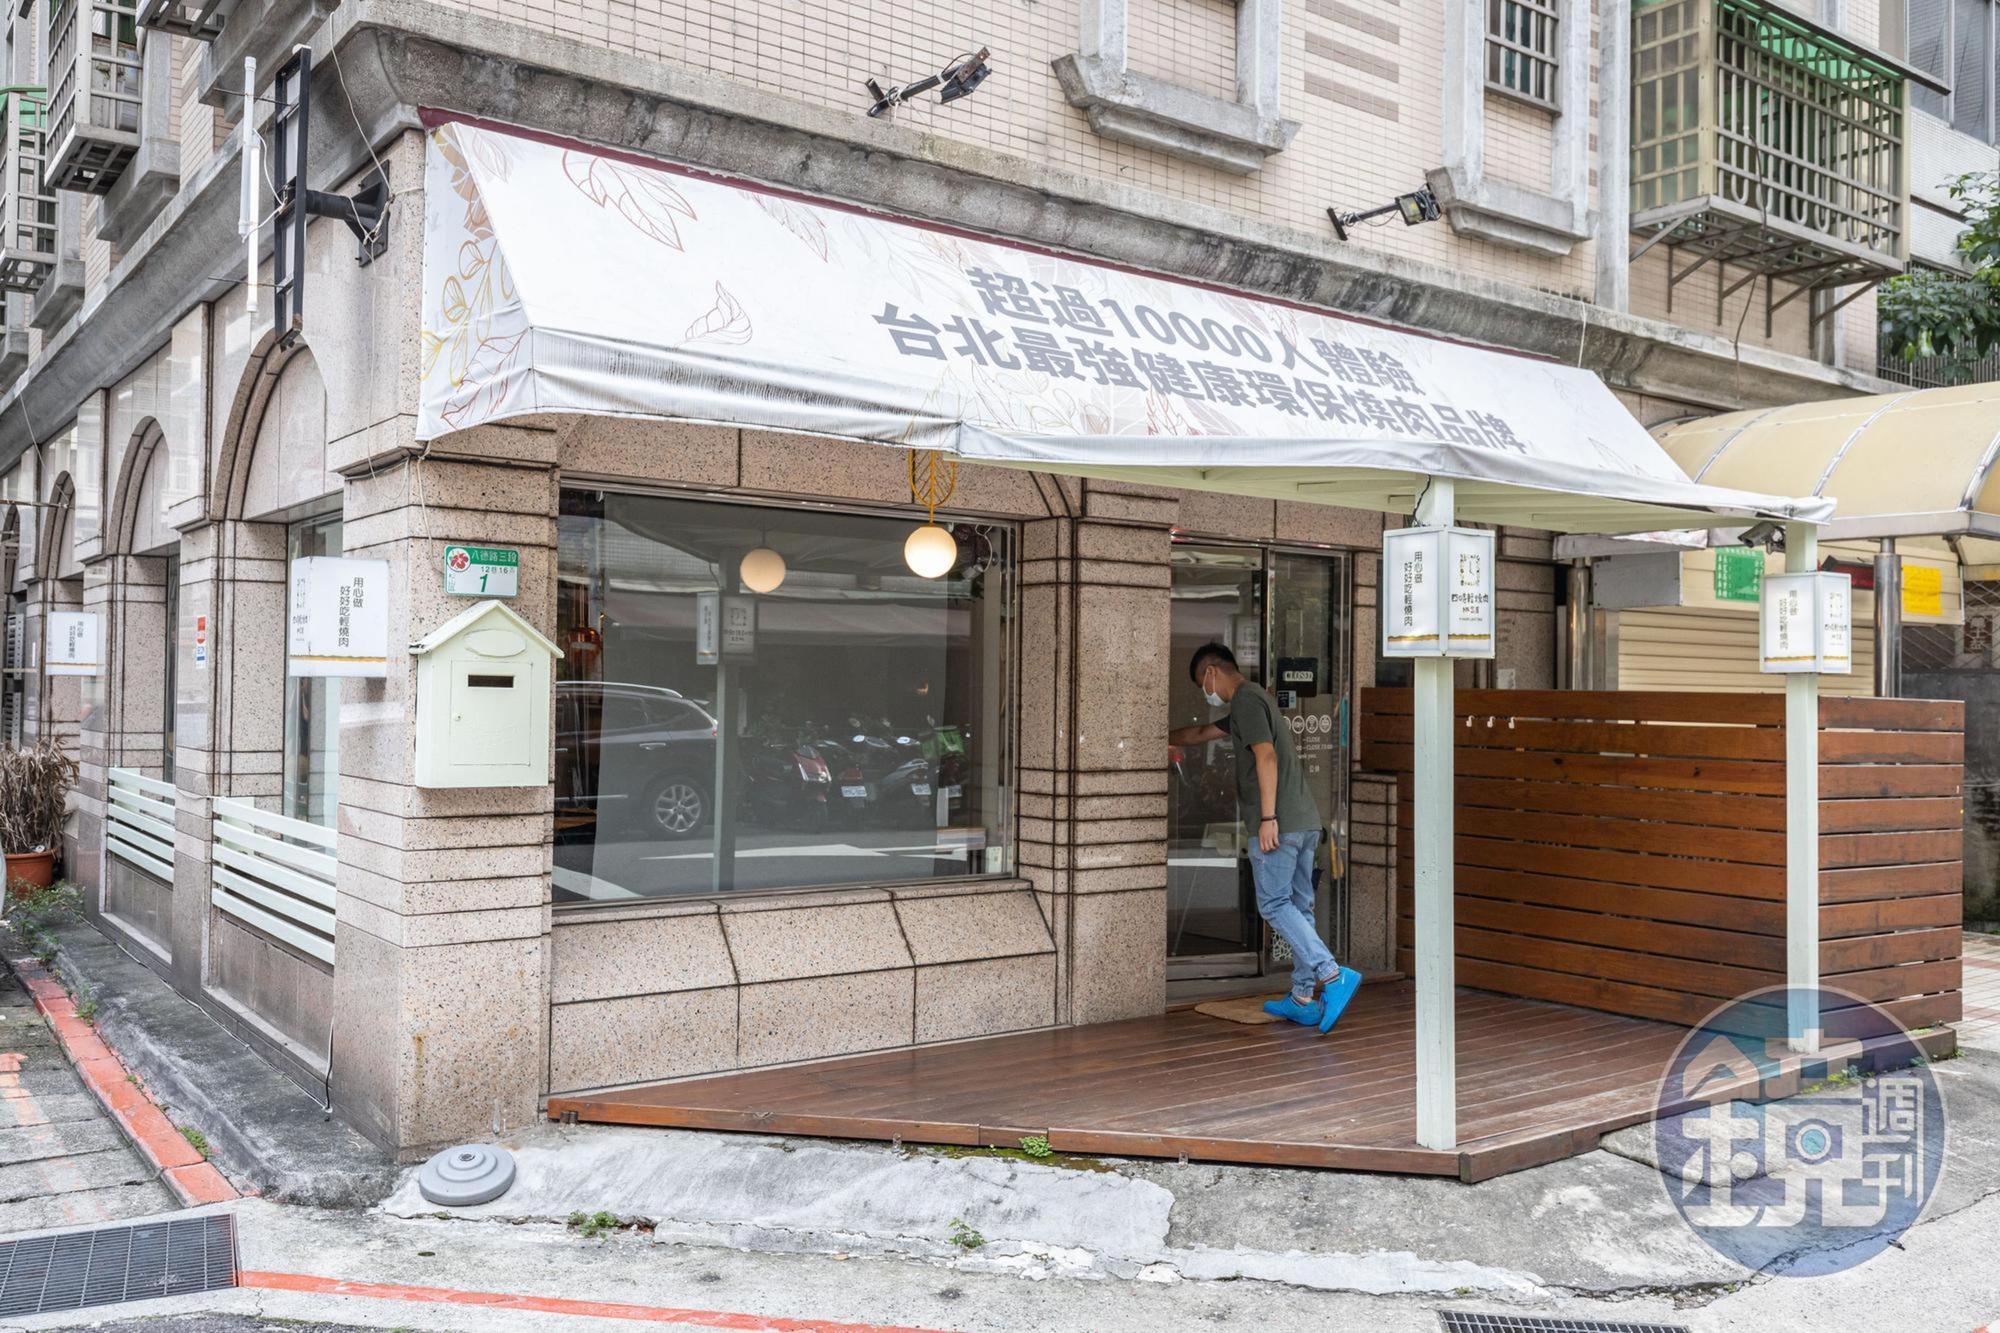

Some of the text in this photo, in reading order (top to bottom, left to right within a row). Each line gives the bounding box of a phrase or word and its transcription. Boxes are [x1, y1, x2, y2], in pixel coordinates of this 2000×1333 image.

[965, 266, 1422, 398] 超過10000人體驗
[873, 303, 1529, 455] 台北最強健康環保燒肉品牌
[471, 550, 517, 562] 八德路三段
[1414, 551, 1423, 584] 用心做
[352, 577, 364, 608] 用心做
[480, 574, 488, 592] 1
[1404, 561, 1413, 626] 好好吃輕燒肉
[338, 585, 351, 647] 好好吃輕燒肉
